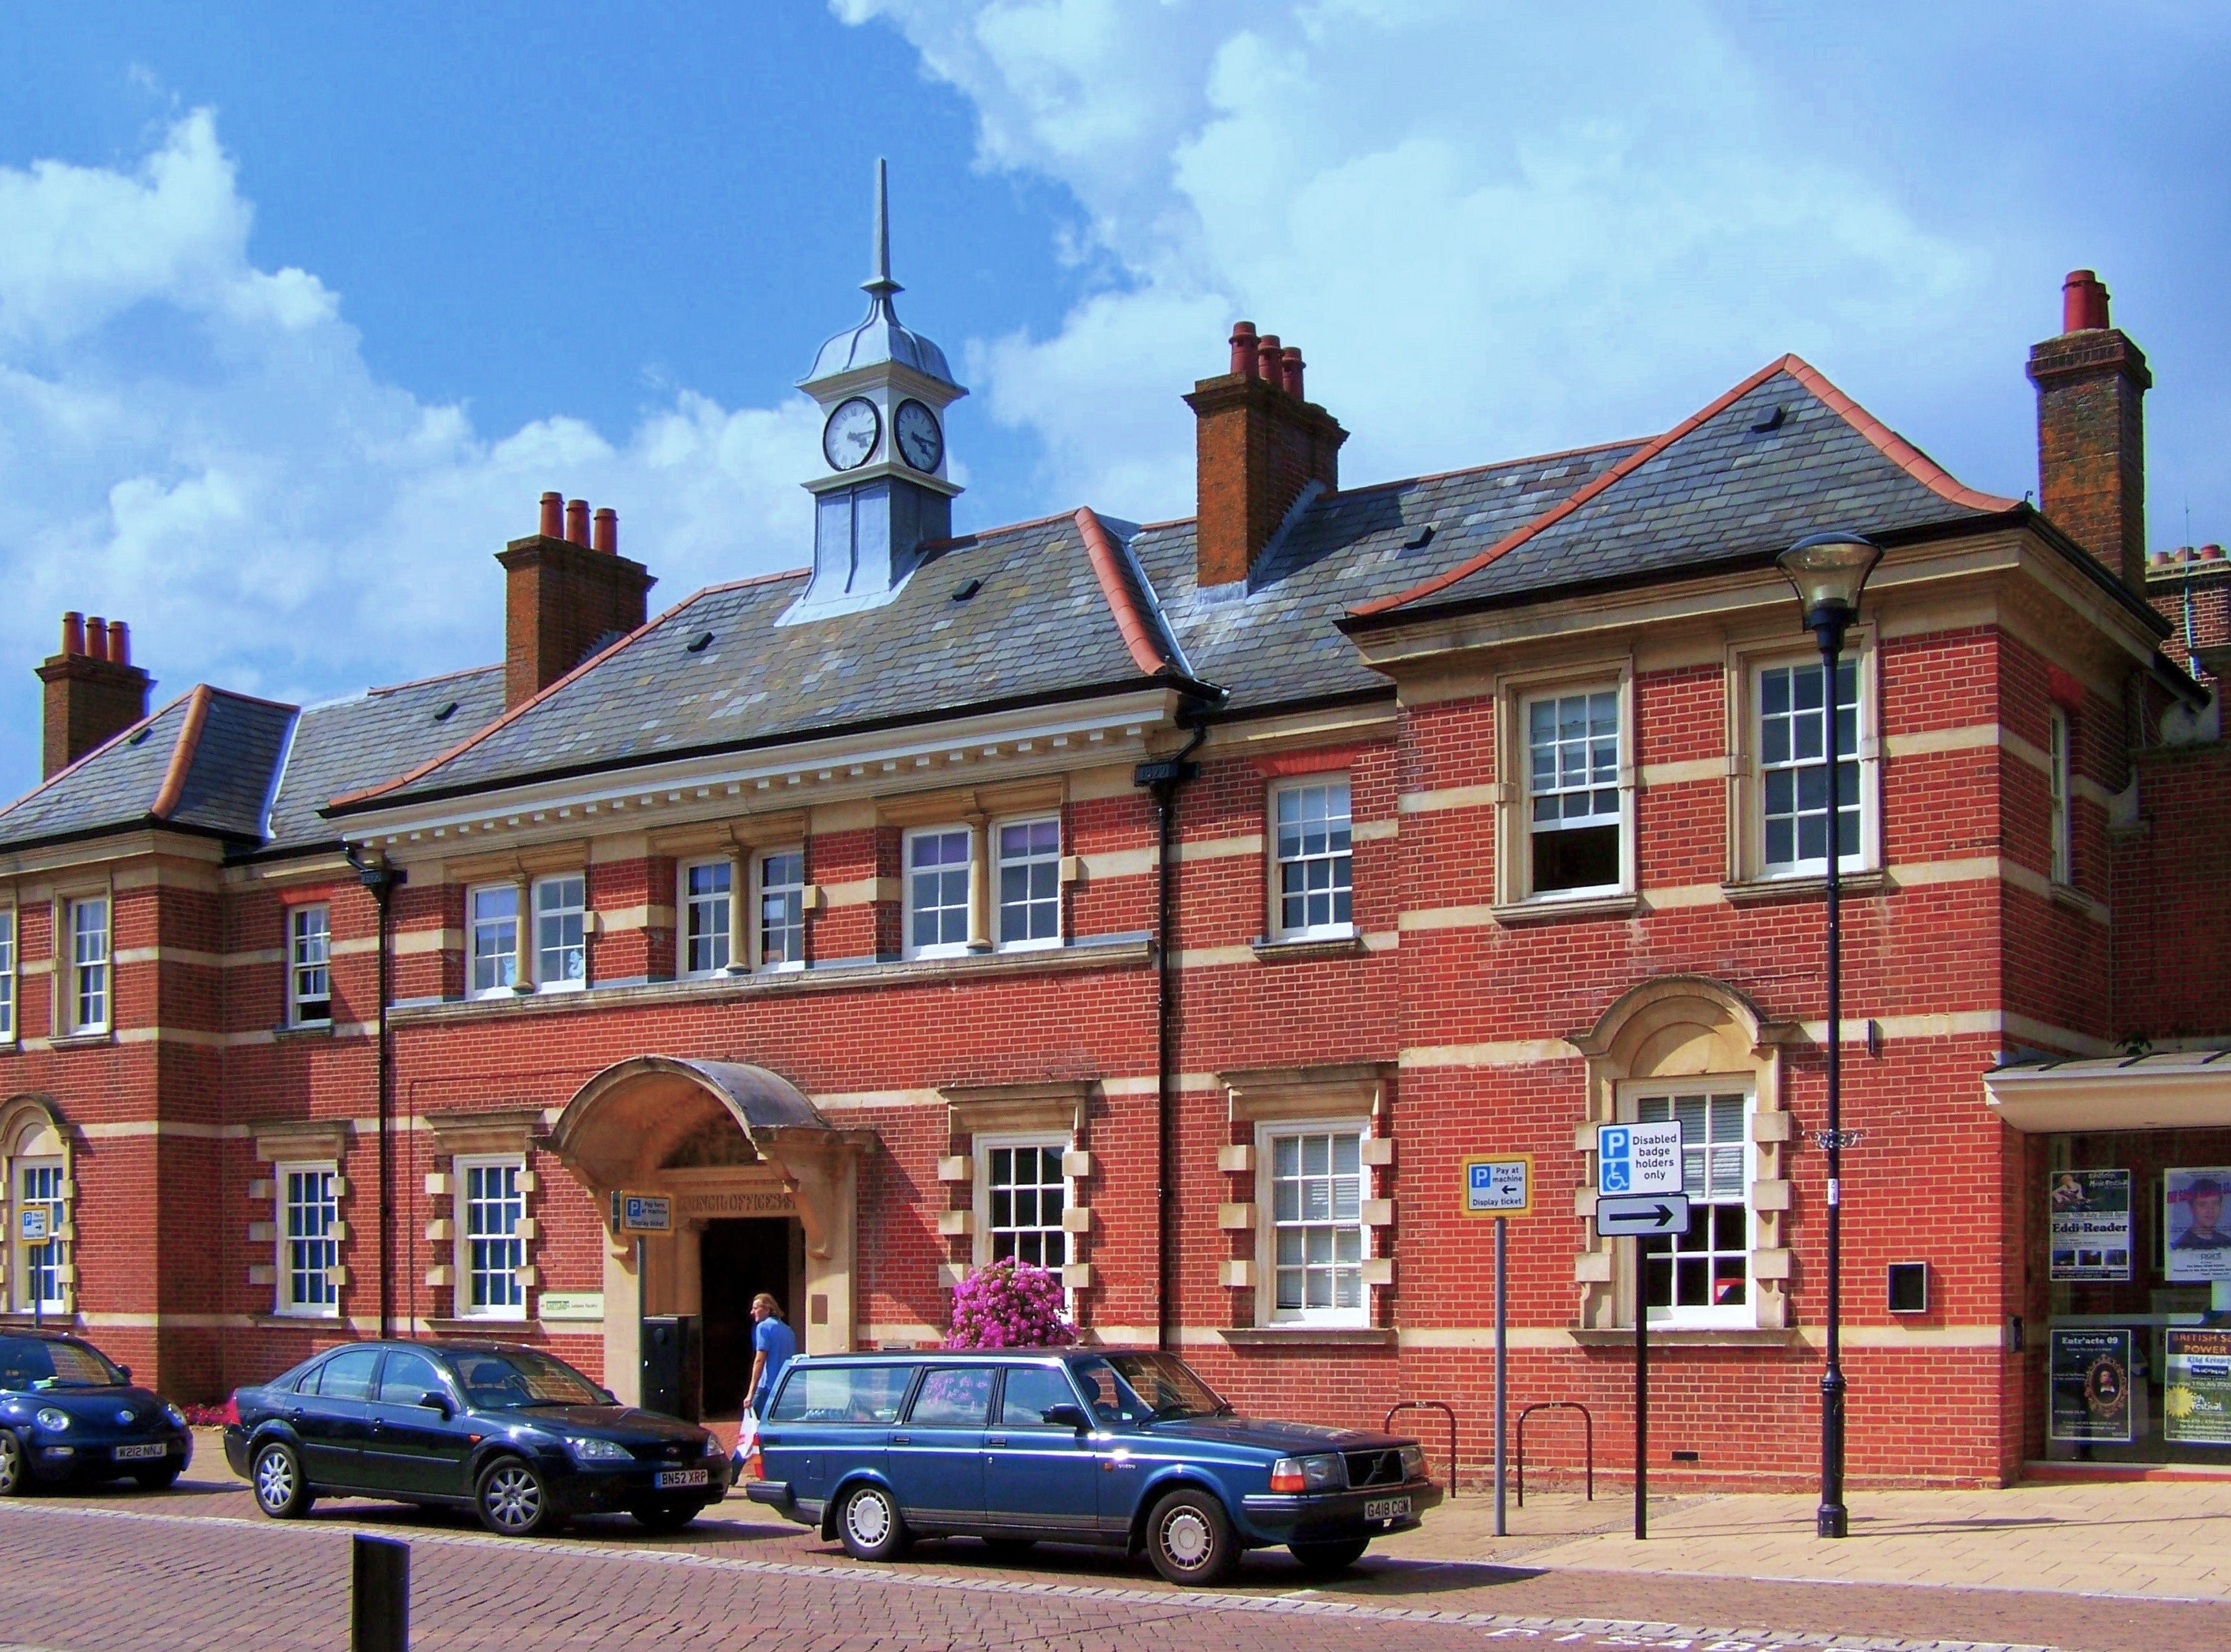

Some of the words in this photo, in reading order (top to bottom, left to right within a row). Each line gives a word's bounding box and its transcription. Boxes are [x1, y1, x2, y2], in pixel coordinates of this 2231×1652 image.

[1608, 1132, 1625, 1156] P
[1633, 1133, 1677, 1145] Disabled
[1639, 1147, 1670, 1157] badge
[1636, 1158, 1674, 1168] holders
[1476, 1168, 1488, 1186] P
[1644, 1170, 1666, 1180] only
[1472, 1198, 1499, 1207] Display
[1501, 1197, 1522, 1205] ticket
[631, 1201, 640, 1215] P
[25, 1213, 32, 1225] P
[2052, 1222, 2080, 1232] Eddi
[2083, 1222, 2128, 1232] Reader
[2172, 1333, 2217, 1342] BRITISH
[2184, 1345, 2226, 1354] POWER
[662, 1473, 686, 1484] BN52
[689, 1471, 706, 1483] XRP
[1367, 1502, 1390, 1517] G418
